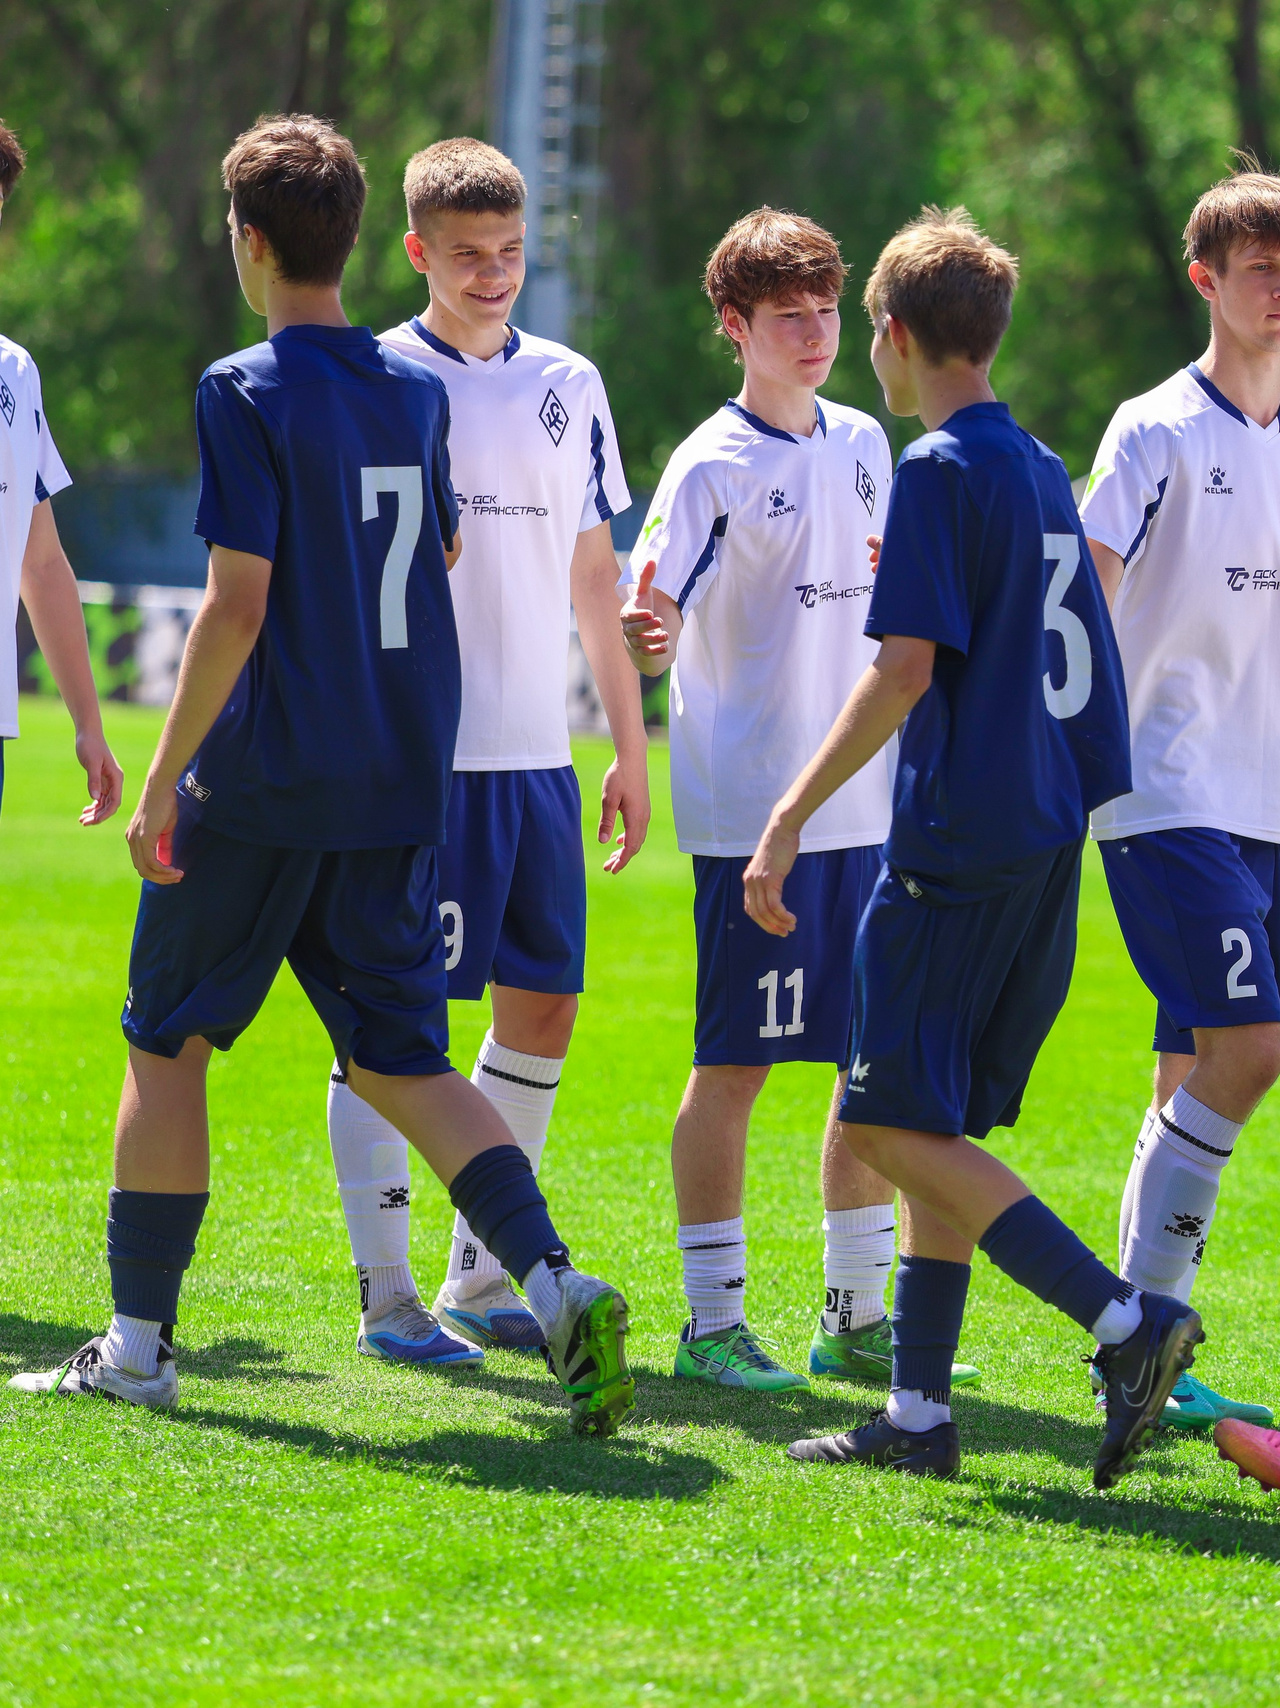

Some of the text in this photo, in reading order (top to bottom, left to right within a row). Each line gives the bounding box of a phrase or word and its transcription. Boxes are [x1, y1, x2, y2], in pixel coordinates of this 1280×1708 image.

[767, 504, 797, 519] KELME
[1204, 486, 1234, 495] KELME
[360, 465, 424, 649] 7
[1042, 532, 1093, 720] 3
[438, 900, 464, 971] 9
[1221, 927, 1258, 999] 2
[757, 968, 805, 1038] 11
[379, 1201, 410, 1210] KELM
